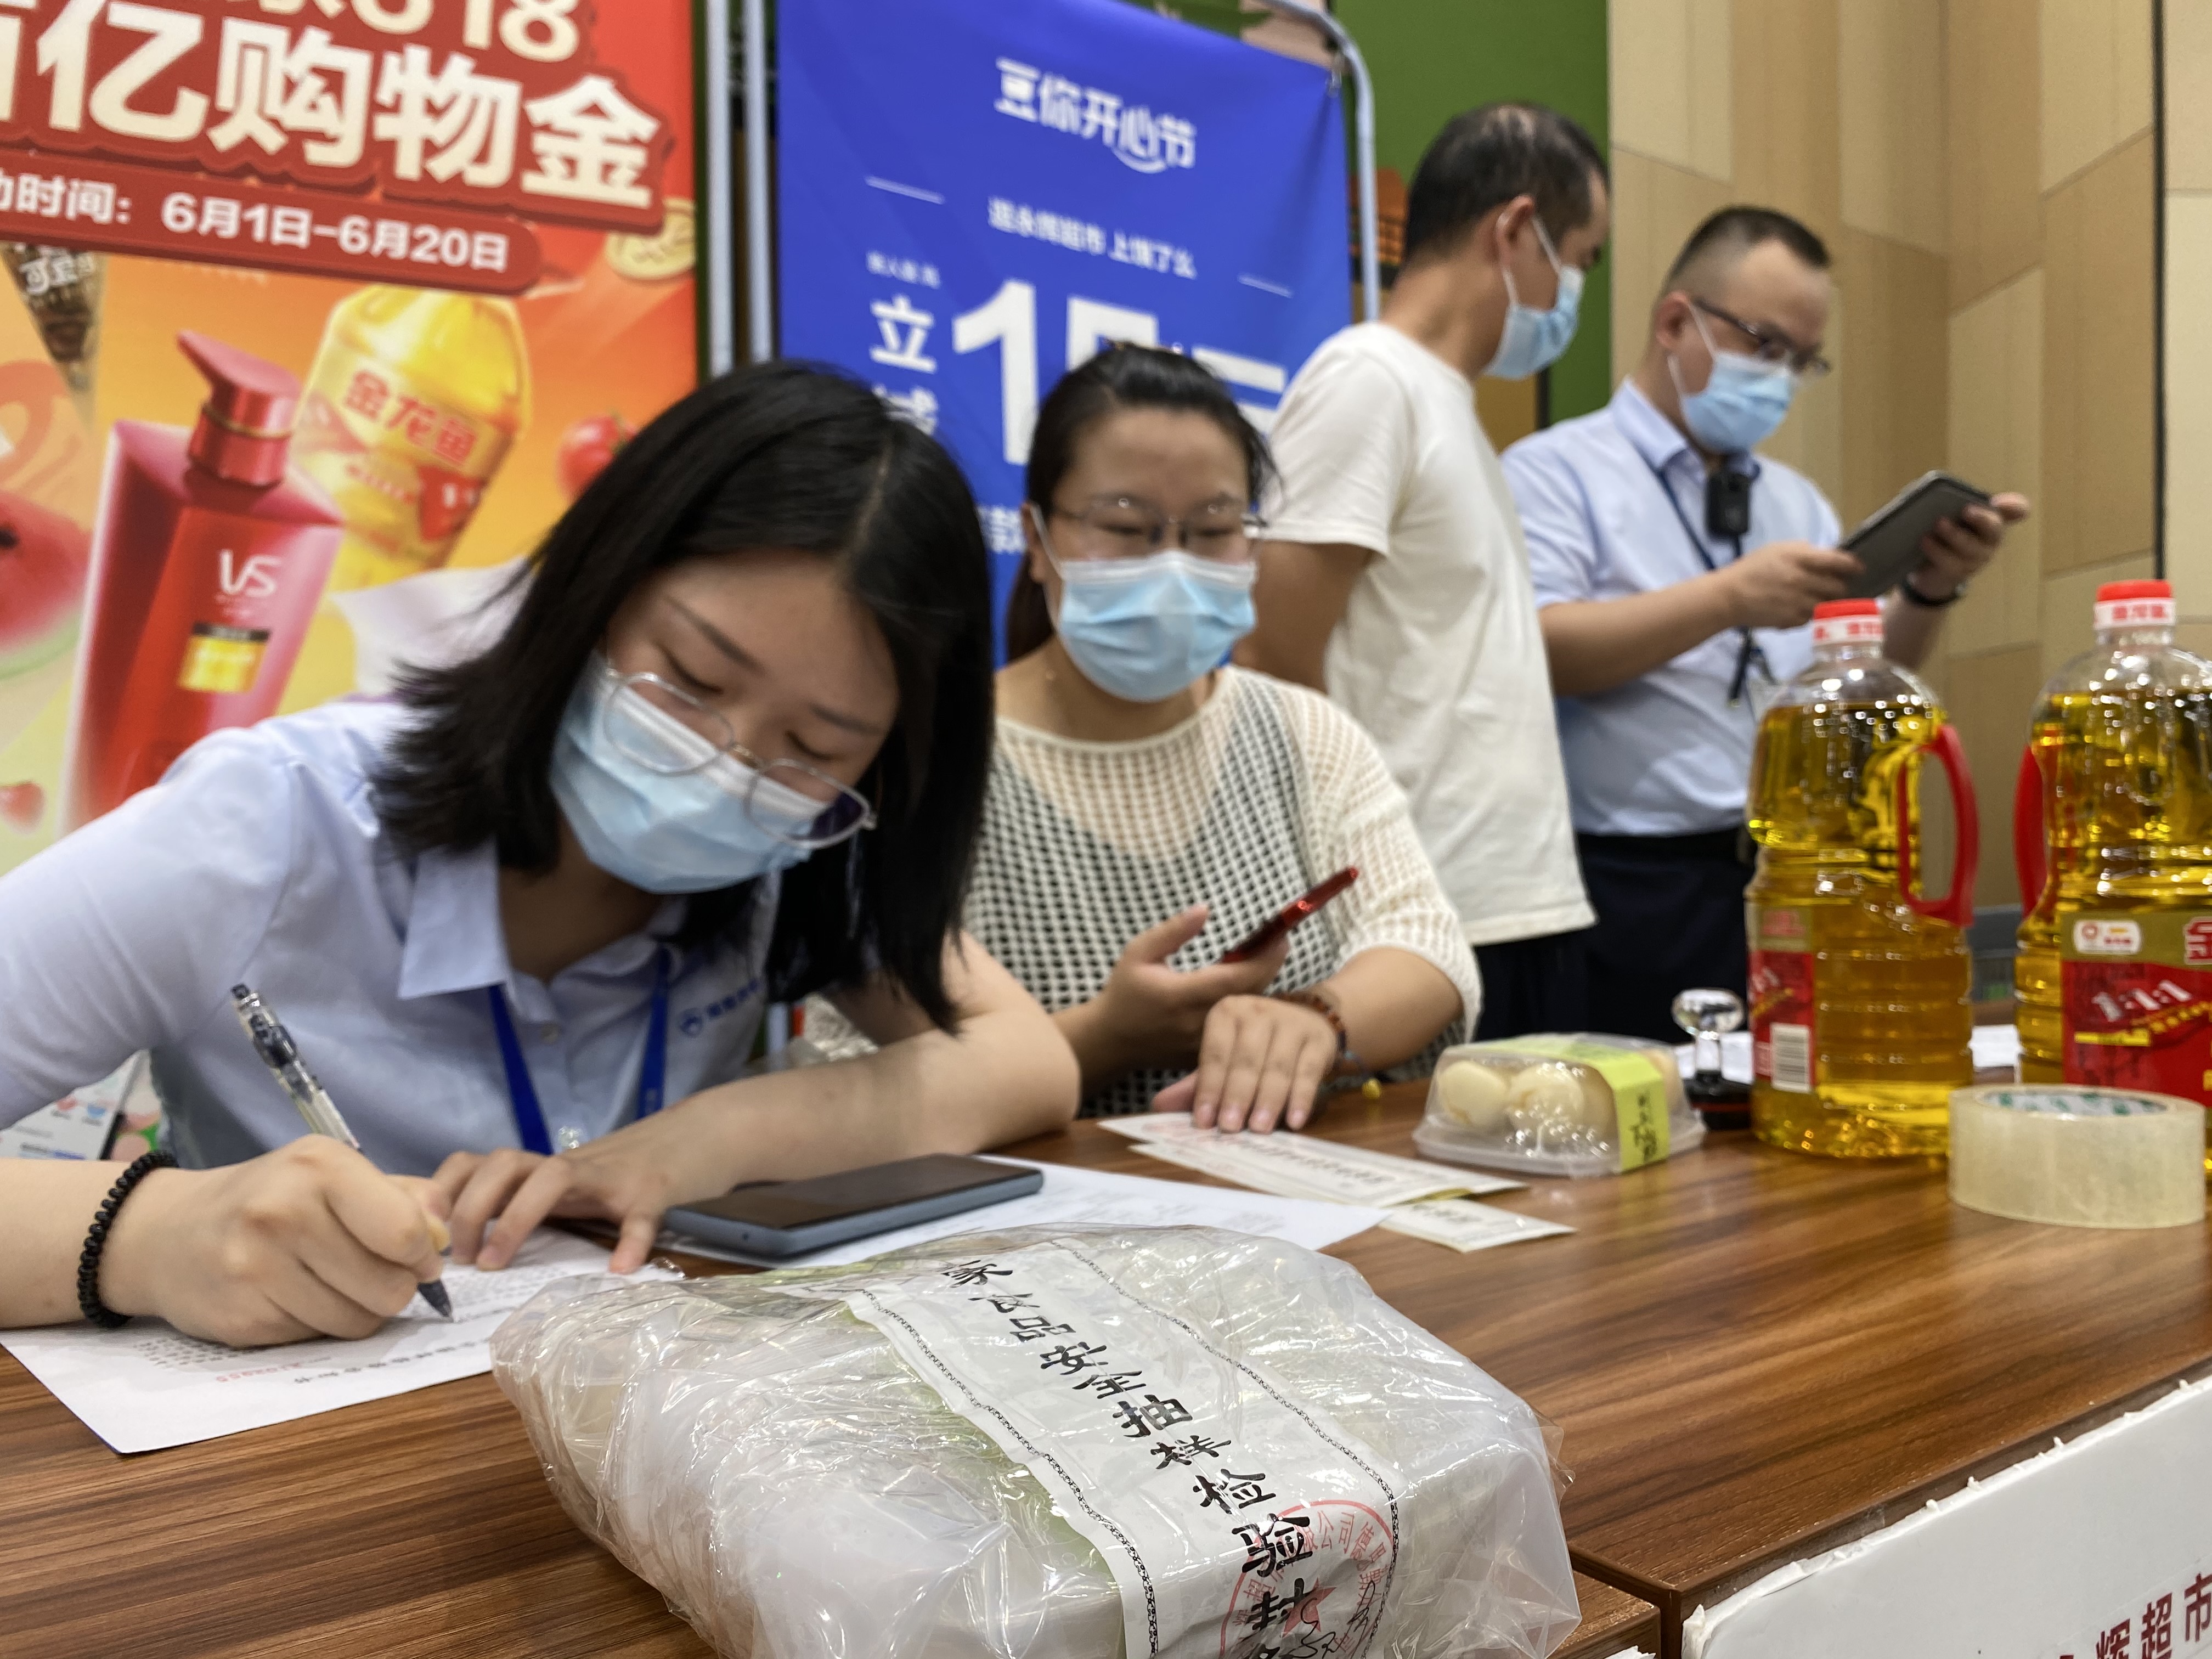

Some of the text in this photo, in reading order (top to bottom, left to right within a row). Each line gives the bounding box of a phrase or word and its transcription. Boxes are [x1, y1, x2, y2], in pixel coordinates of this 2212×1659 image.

[0, 0, 662, 210] 亿购物金
[220, 549, 281, 598] VS
[2059, 1572, 2212, 1659] 辉超市
